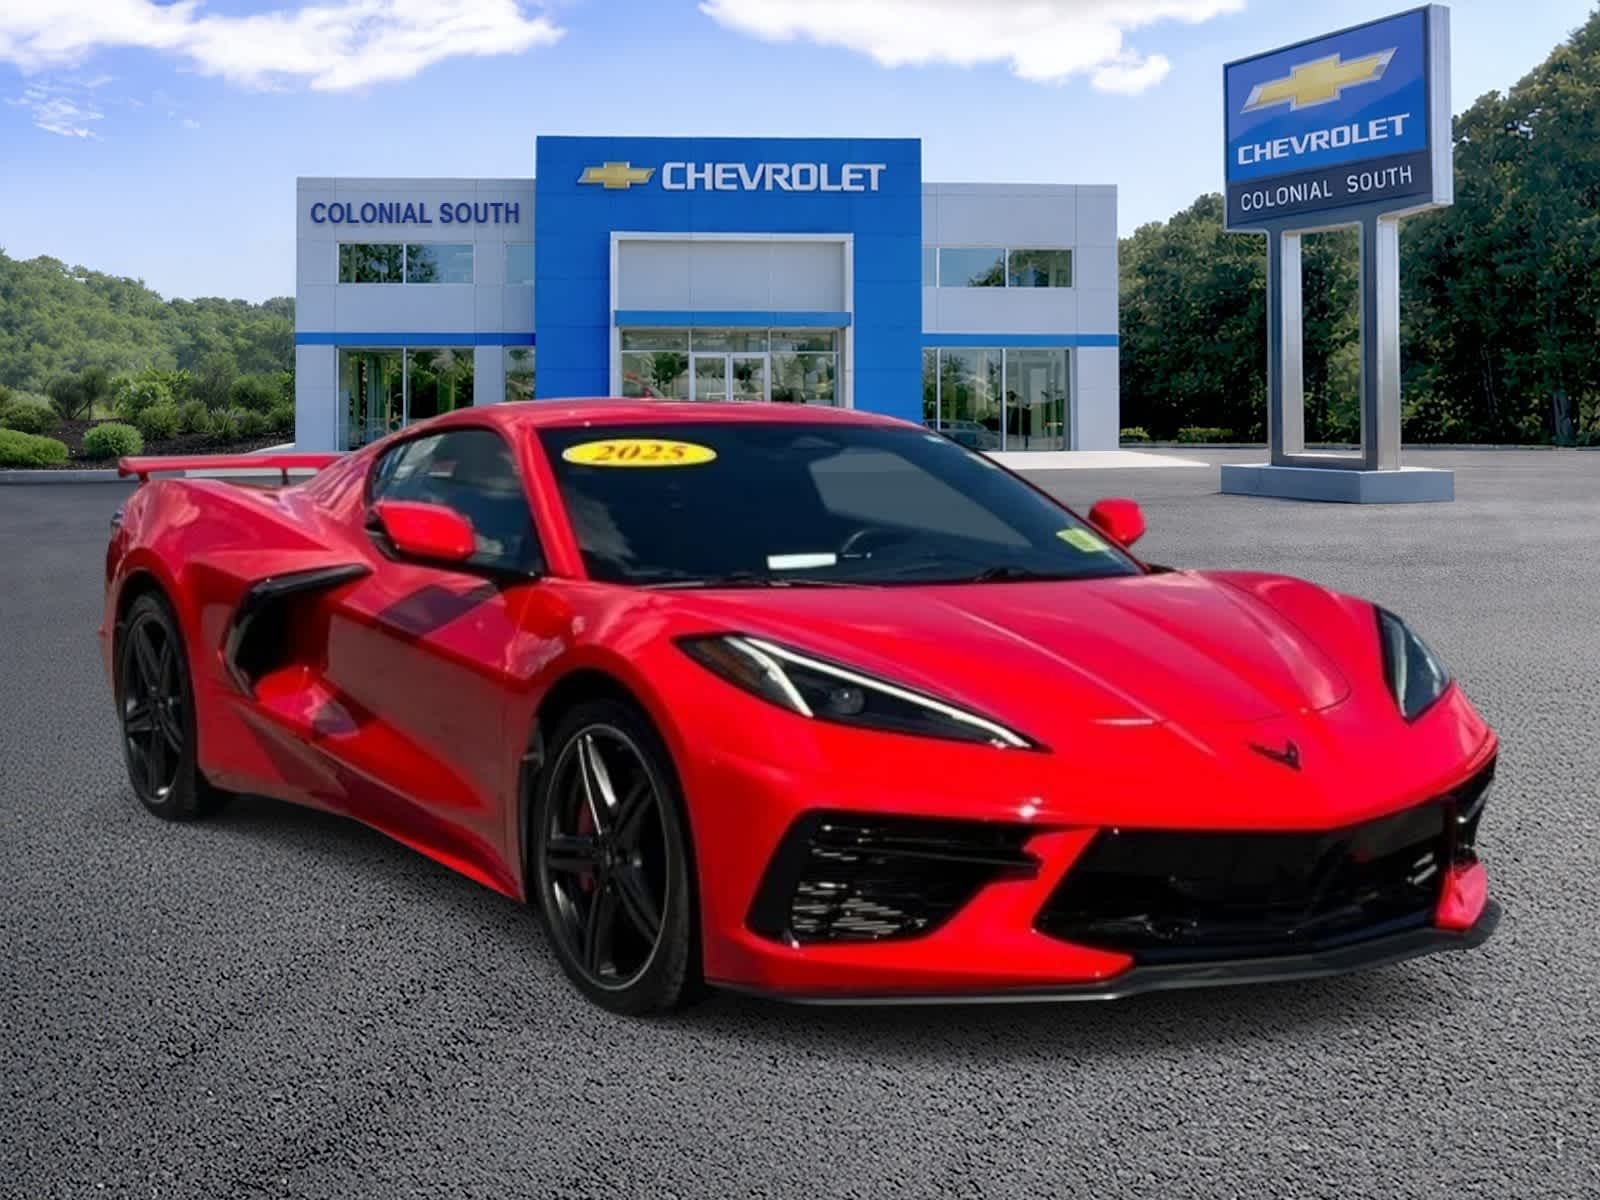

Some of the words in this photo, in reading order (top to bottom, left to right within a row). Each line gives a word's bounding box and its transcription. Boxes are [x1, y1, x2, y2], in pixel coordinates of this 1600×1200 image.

[1237, 113, 1410, 165] CHEVROLET
[662, 162, 887, 191] CHEVROLET
[1240, 180, 1333, 211] COLONIAL
[1346, 165, 1412, 193] SOUTH
[310, 202, 432, 224] COLONIAL
[439, 202, 520, 224] SOUTH
[592, 444, 688, 461] 2025
